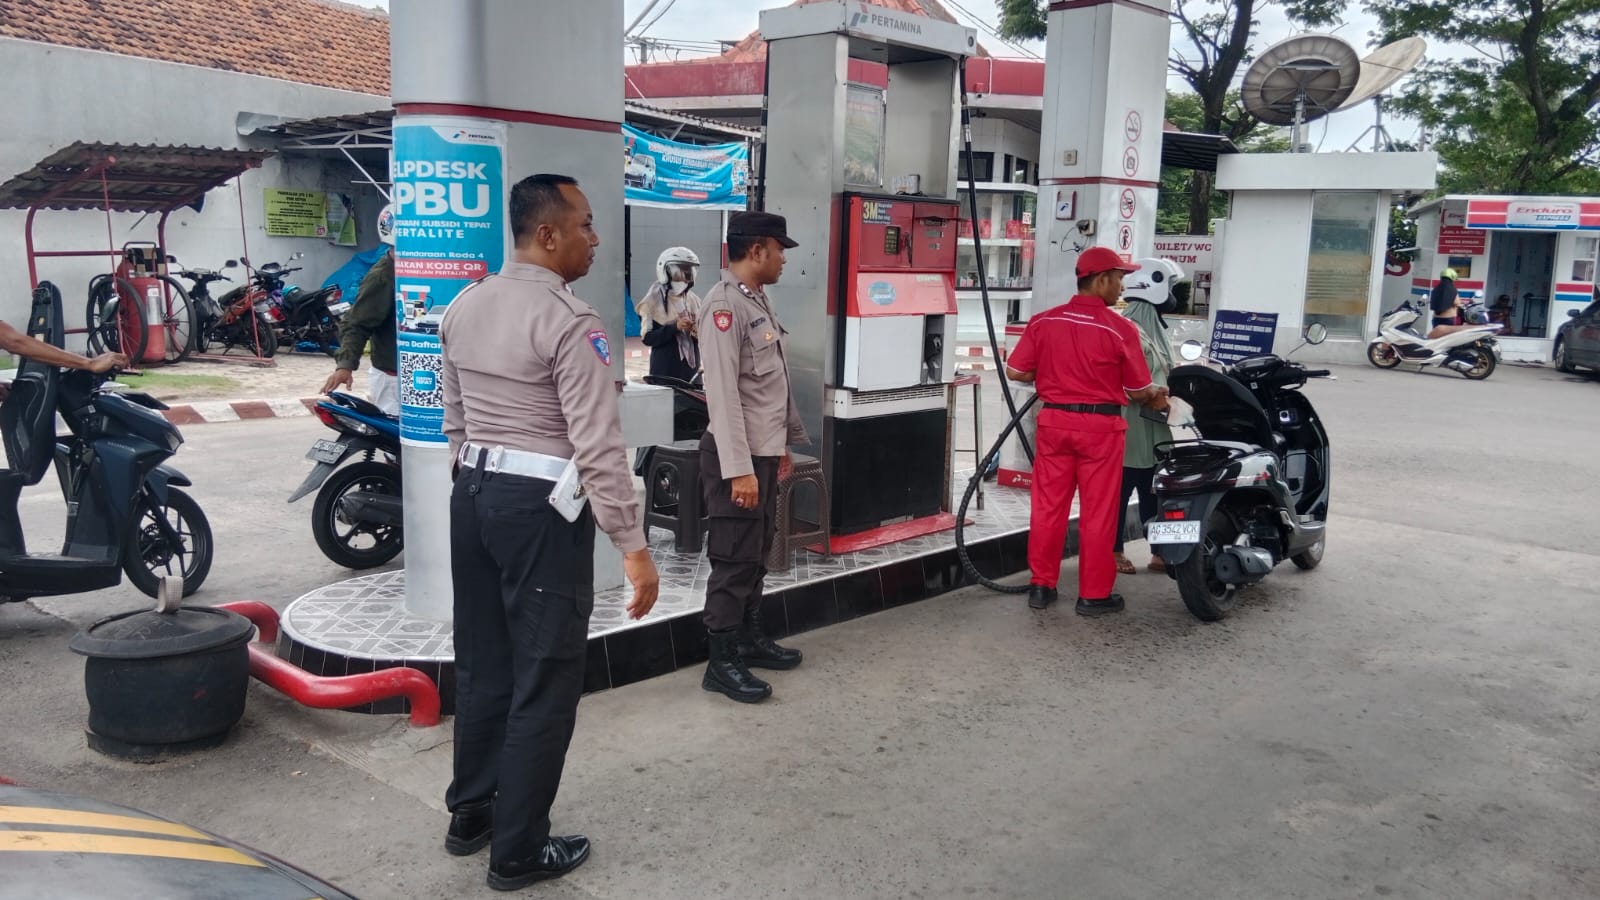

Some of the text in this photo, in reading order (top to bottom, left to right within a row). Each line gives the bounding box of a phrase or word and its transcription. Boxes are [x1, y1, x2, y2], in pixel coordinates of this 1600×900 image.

[871, 14, 922, 35] PERTAMINA
[863, 201, 878, 220] 3M
[426, 262, 460, 270] KODE
[463, 263, 482, 271] QR
[1151, 524, 1161, 536] AG
[1161, 524, 1181, 534] 3542
